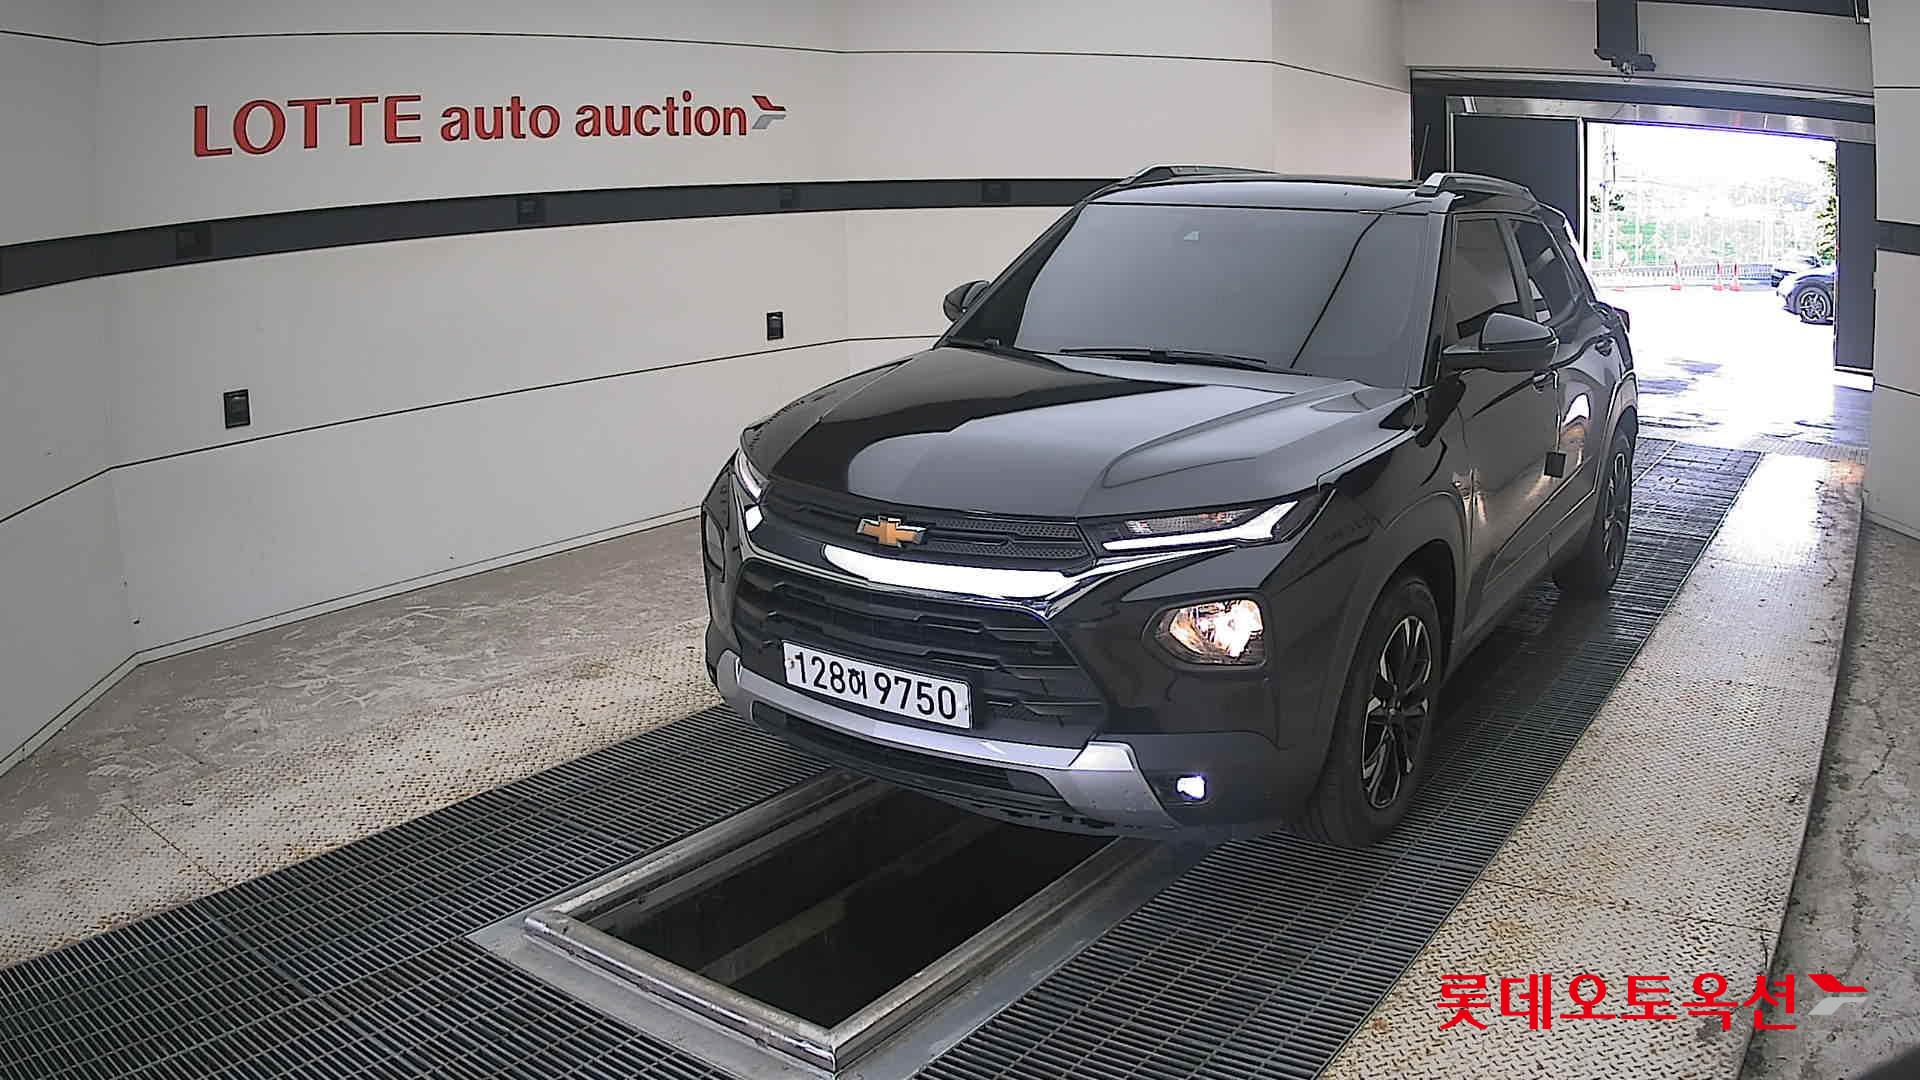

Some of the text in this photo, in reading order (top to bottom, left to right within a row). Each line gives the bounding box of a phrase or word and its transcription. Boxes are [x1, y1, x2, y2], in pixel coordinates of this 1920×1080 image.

[193, 91, 747, 157] LOTTE auto auction
